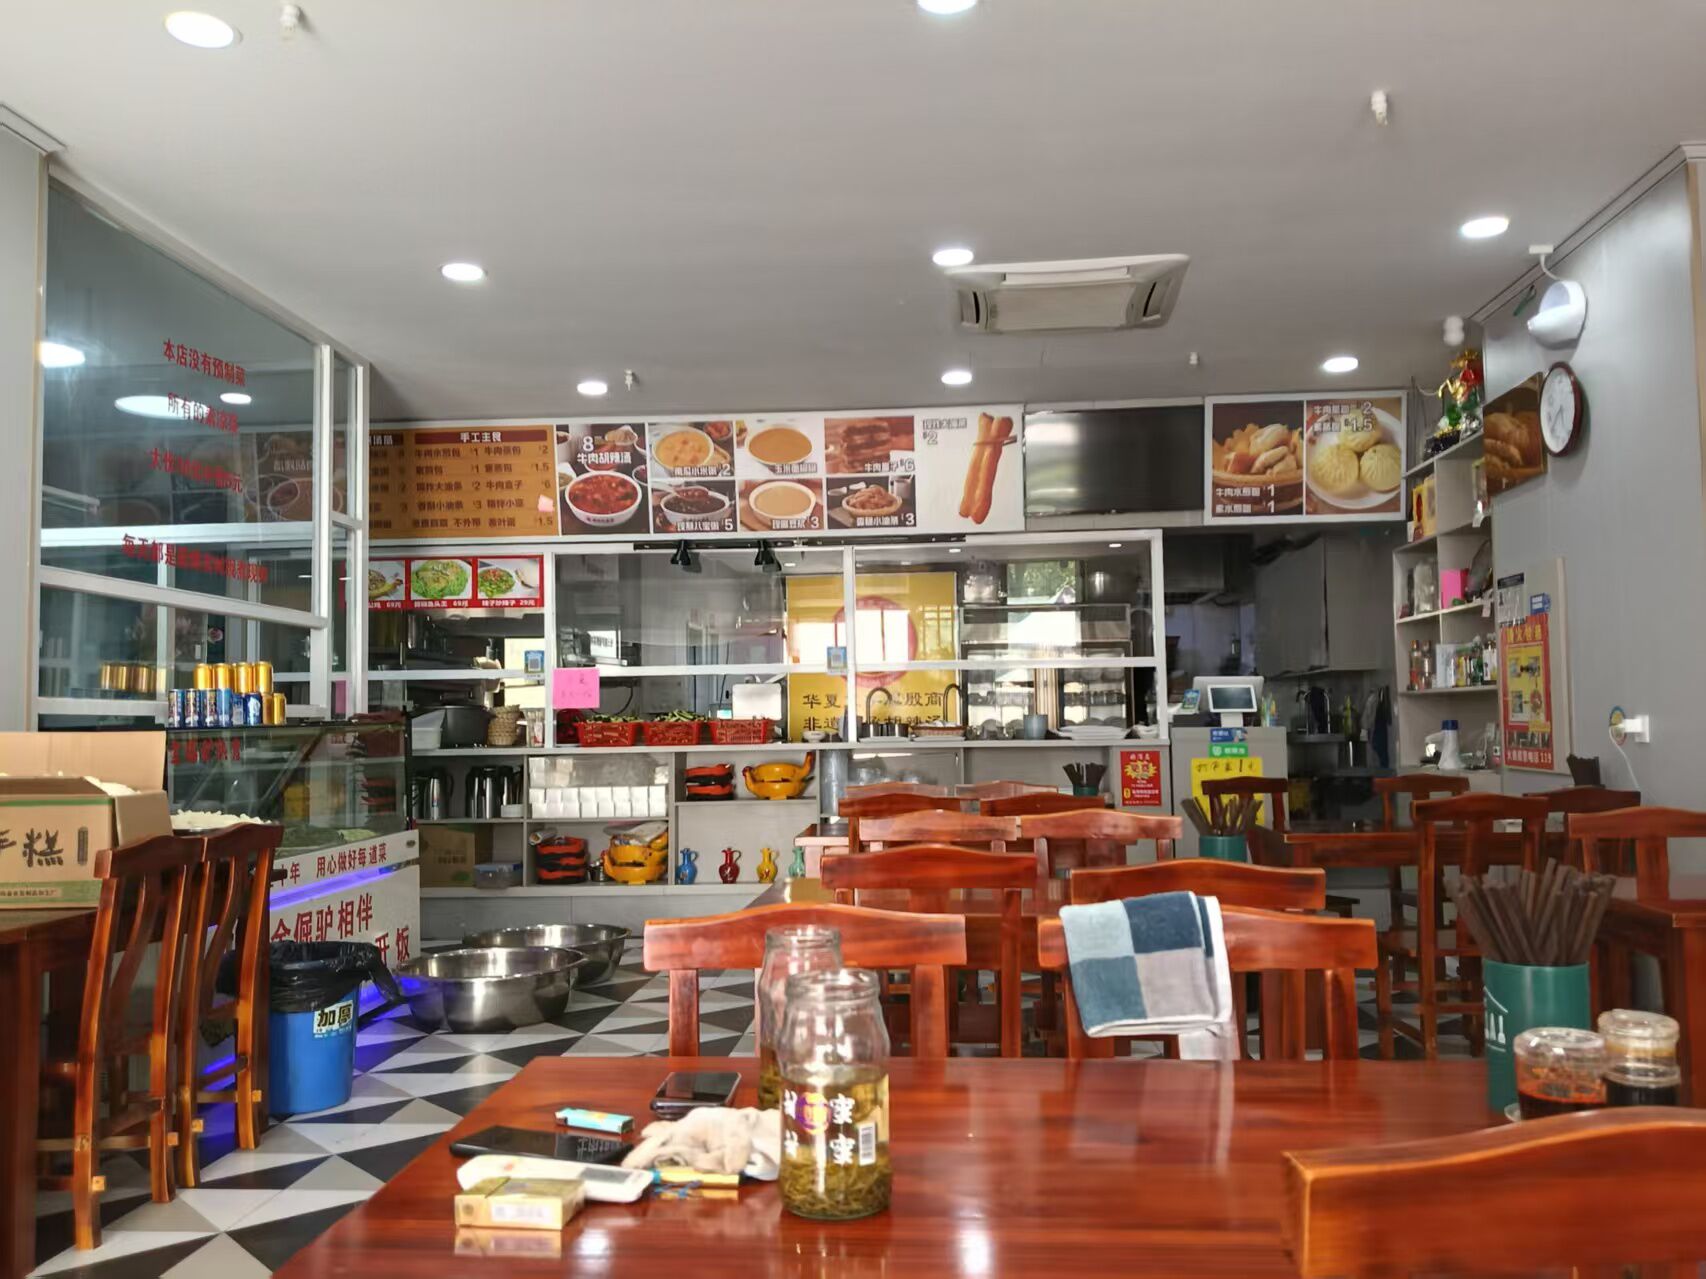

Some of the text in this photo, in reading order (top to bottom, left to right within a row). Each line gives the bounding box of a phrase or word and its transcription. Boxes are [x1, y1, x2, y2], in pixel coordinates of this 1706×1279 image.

[163, 339, 246, 387] 本店没有预制菜
[577, 451, 632, 464] 牛肉胡辣汤
[315, 842, 397, 879] 用心做好每道菜
[317, 1003, 352, 1028] 加厚
